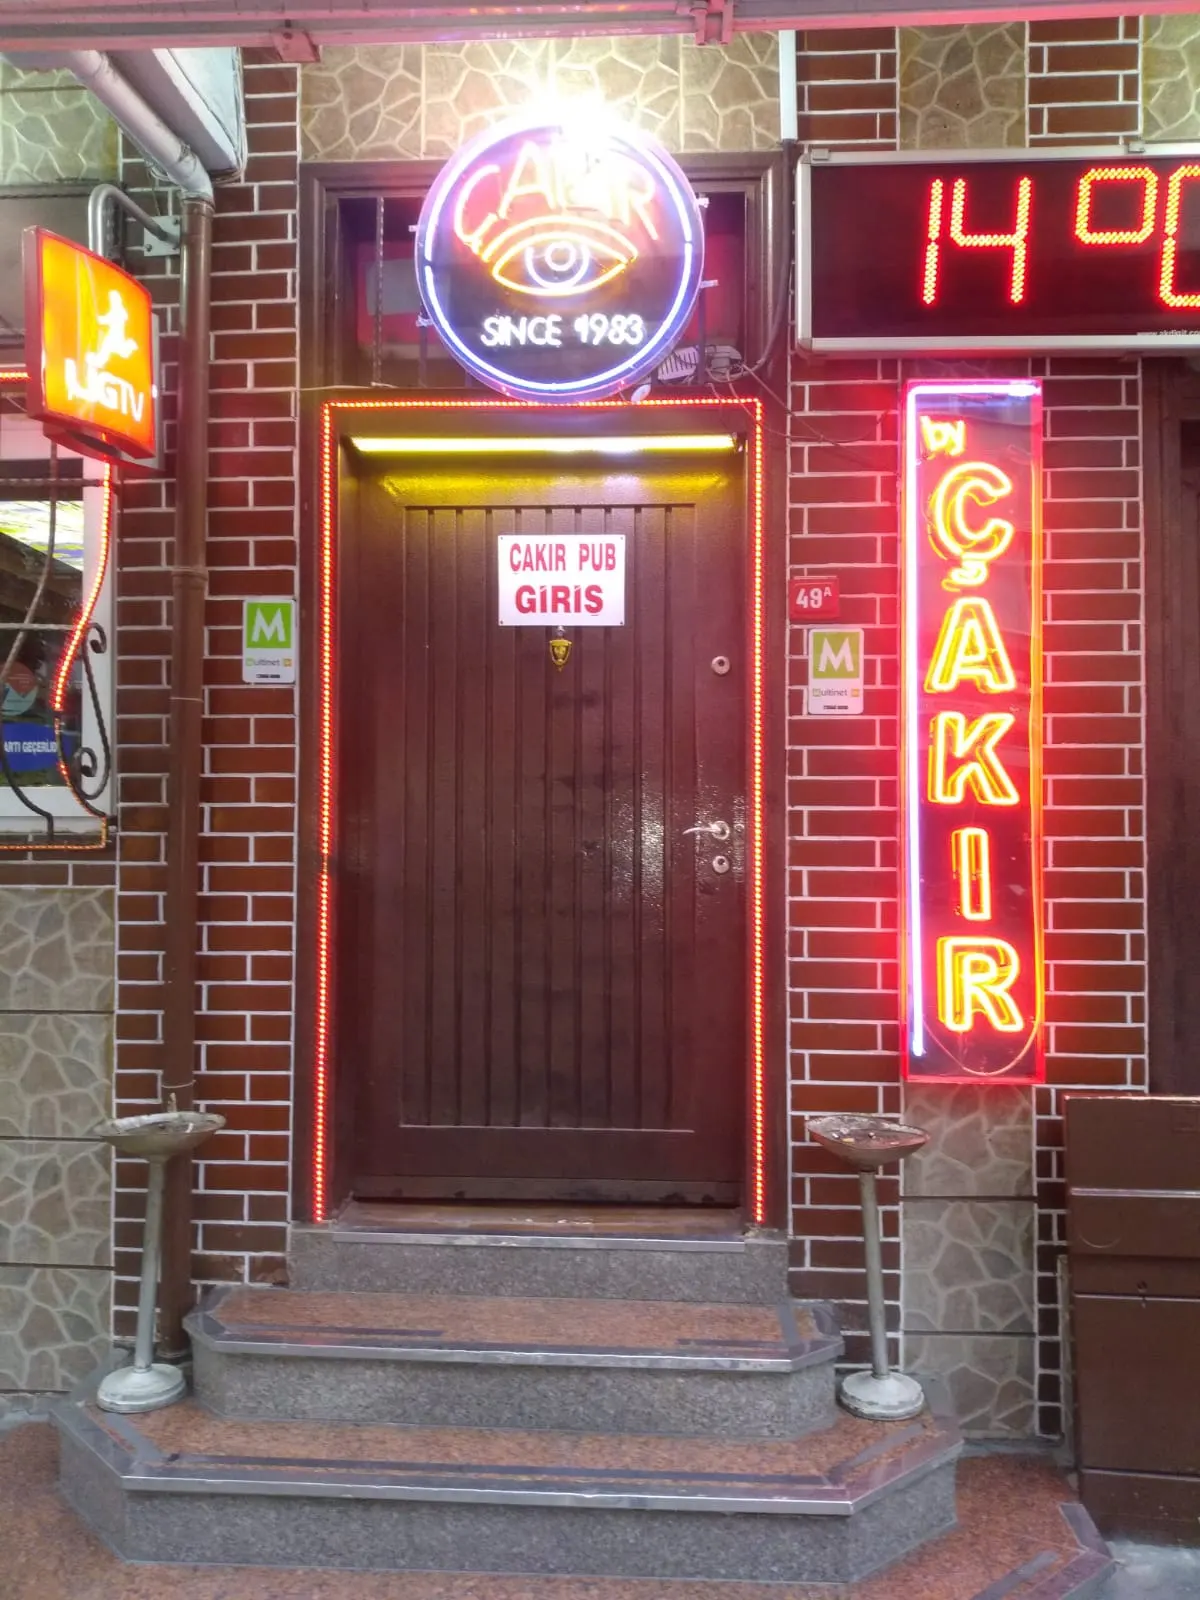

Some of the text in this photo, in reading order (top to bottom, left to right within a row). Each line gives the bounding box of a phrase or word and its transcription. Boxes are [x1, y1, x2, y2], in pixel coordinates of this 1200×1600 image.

[480, 313, 645, 347] SINCE 1983
[919, 415, 965, 457] by
[579, 543, 616, 572] PUB
[924, 461, 1025, 1032] ÇAKIR
